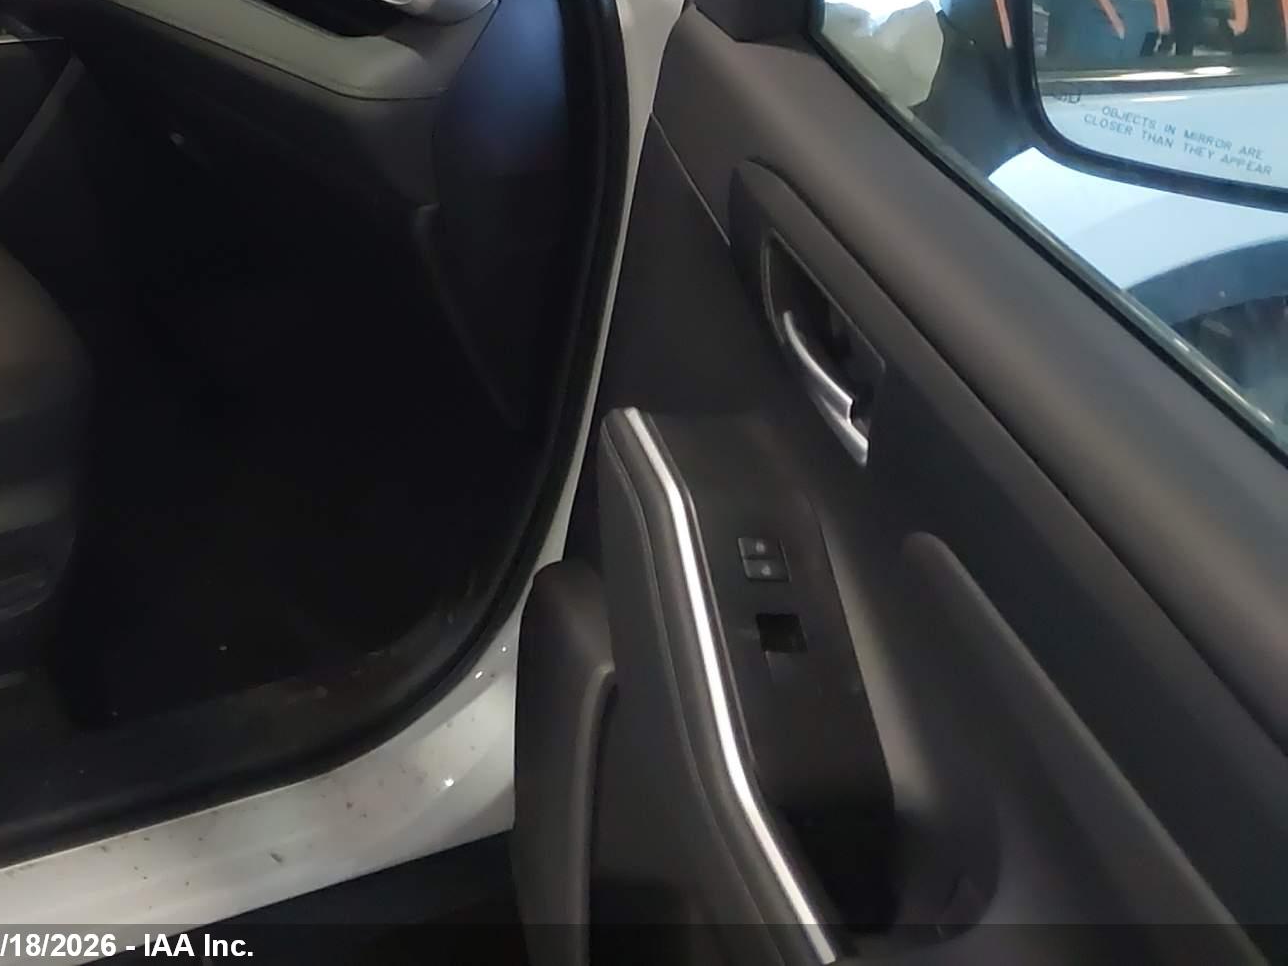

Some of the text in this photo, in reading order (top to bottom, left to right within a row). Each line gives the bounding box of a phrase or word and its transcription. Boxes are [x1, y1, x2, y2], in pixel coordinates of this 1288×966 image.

[1084, 113, 1272, 176] CLOSER THAN THEY APPEAR
[1101, 105, 1264, 160] OBJECTS IN MIRROR ARE
